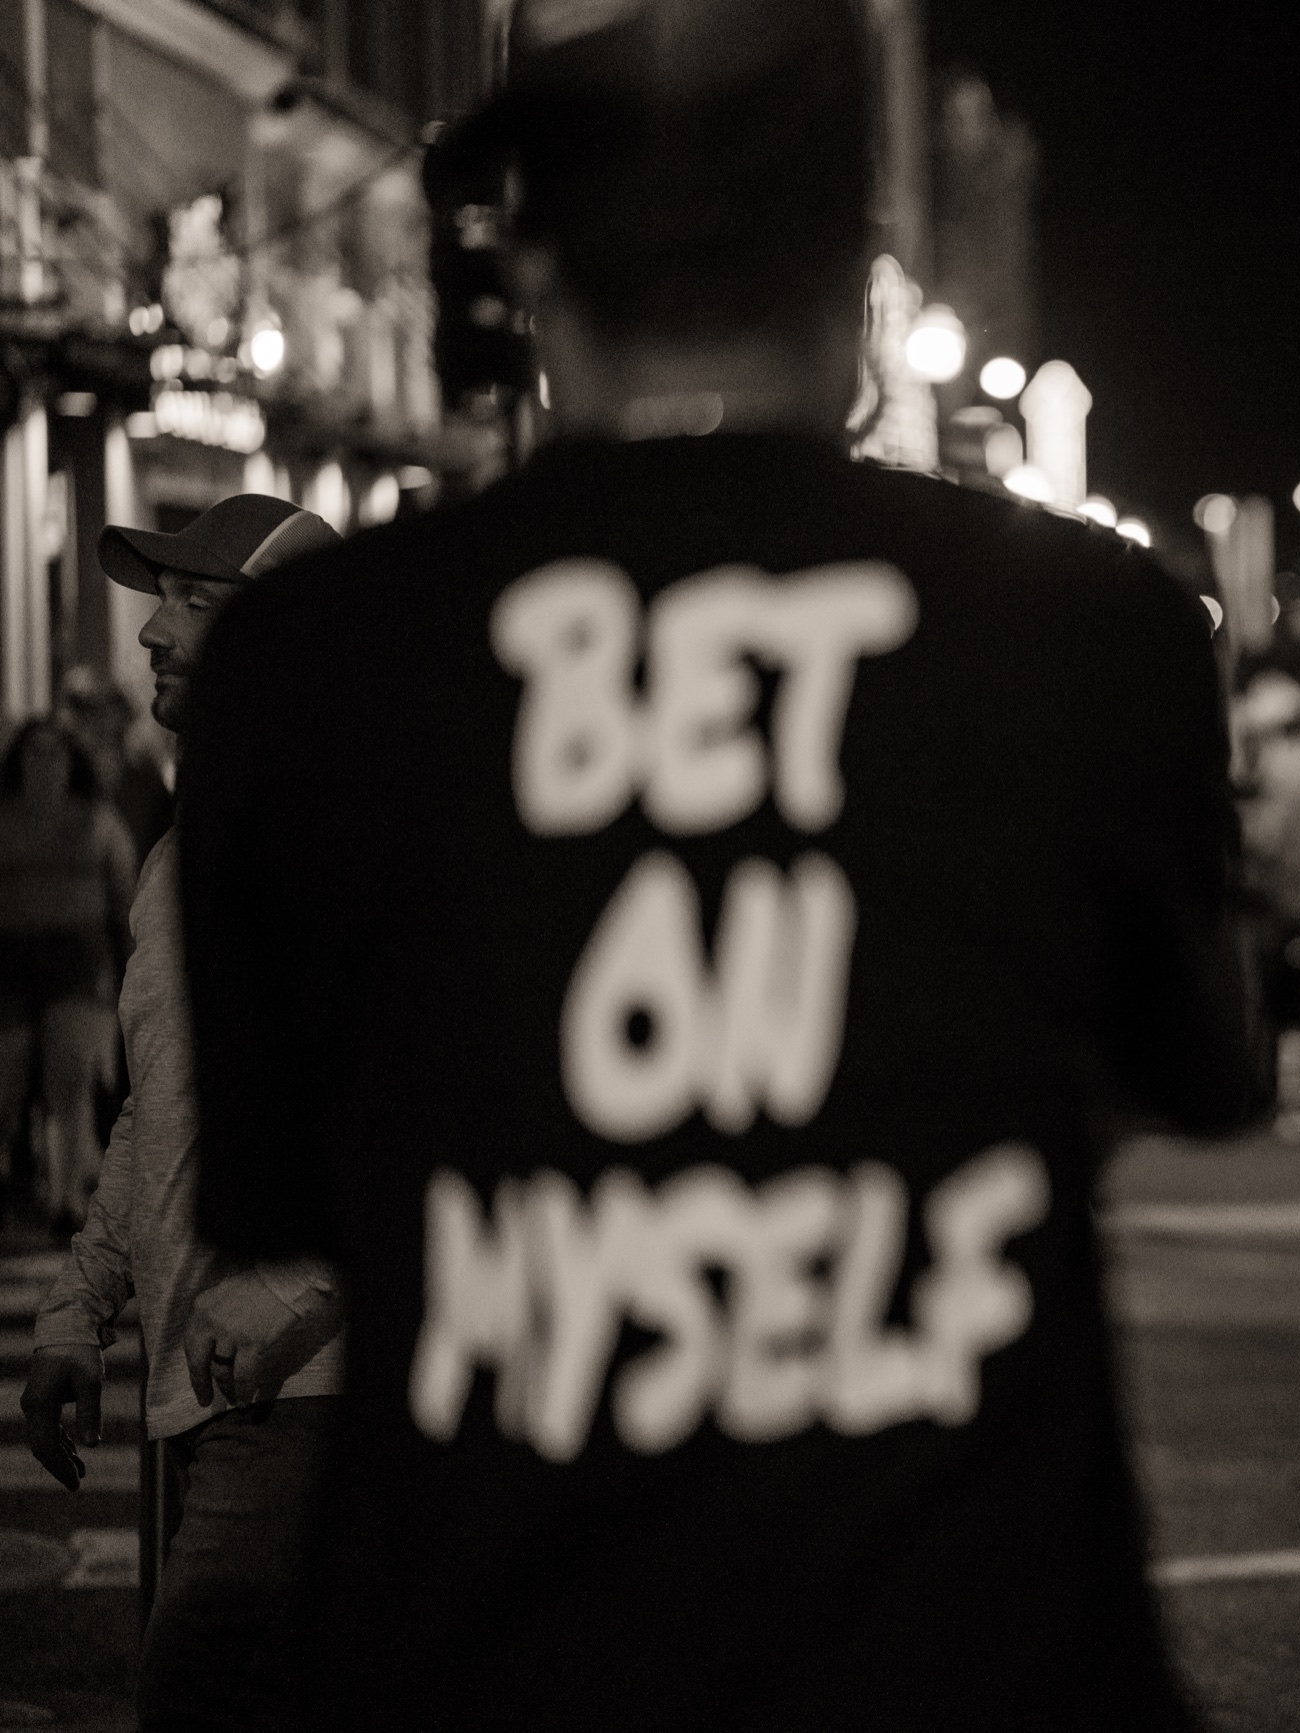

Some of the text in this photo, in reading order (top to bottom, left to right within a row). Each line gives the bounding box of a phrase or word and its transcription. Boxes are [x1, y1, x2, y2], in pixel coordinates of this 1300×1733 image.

[492, 560, 917, 834] BET
[562, 853, 855, 1140] ON
[411, 1146, 1046, 1460] MYSELF
